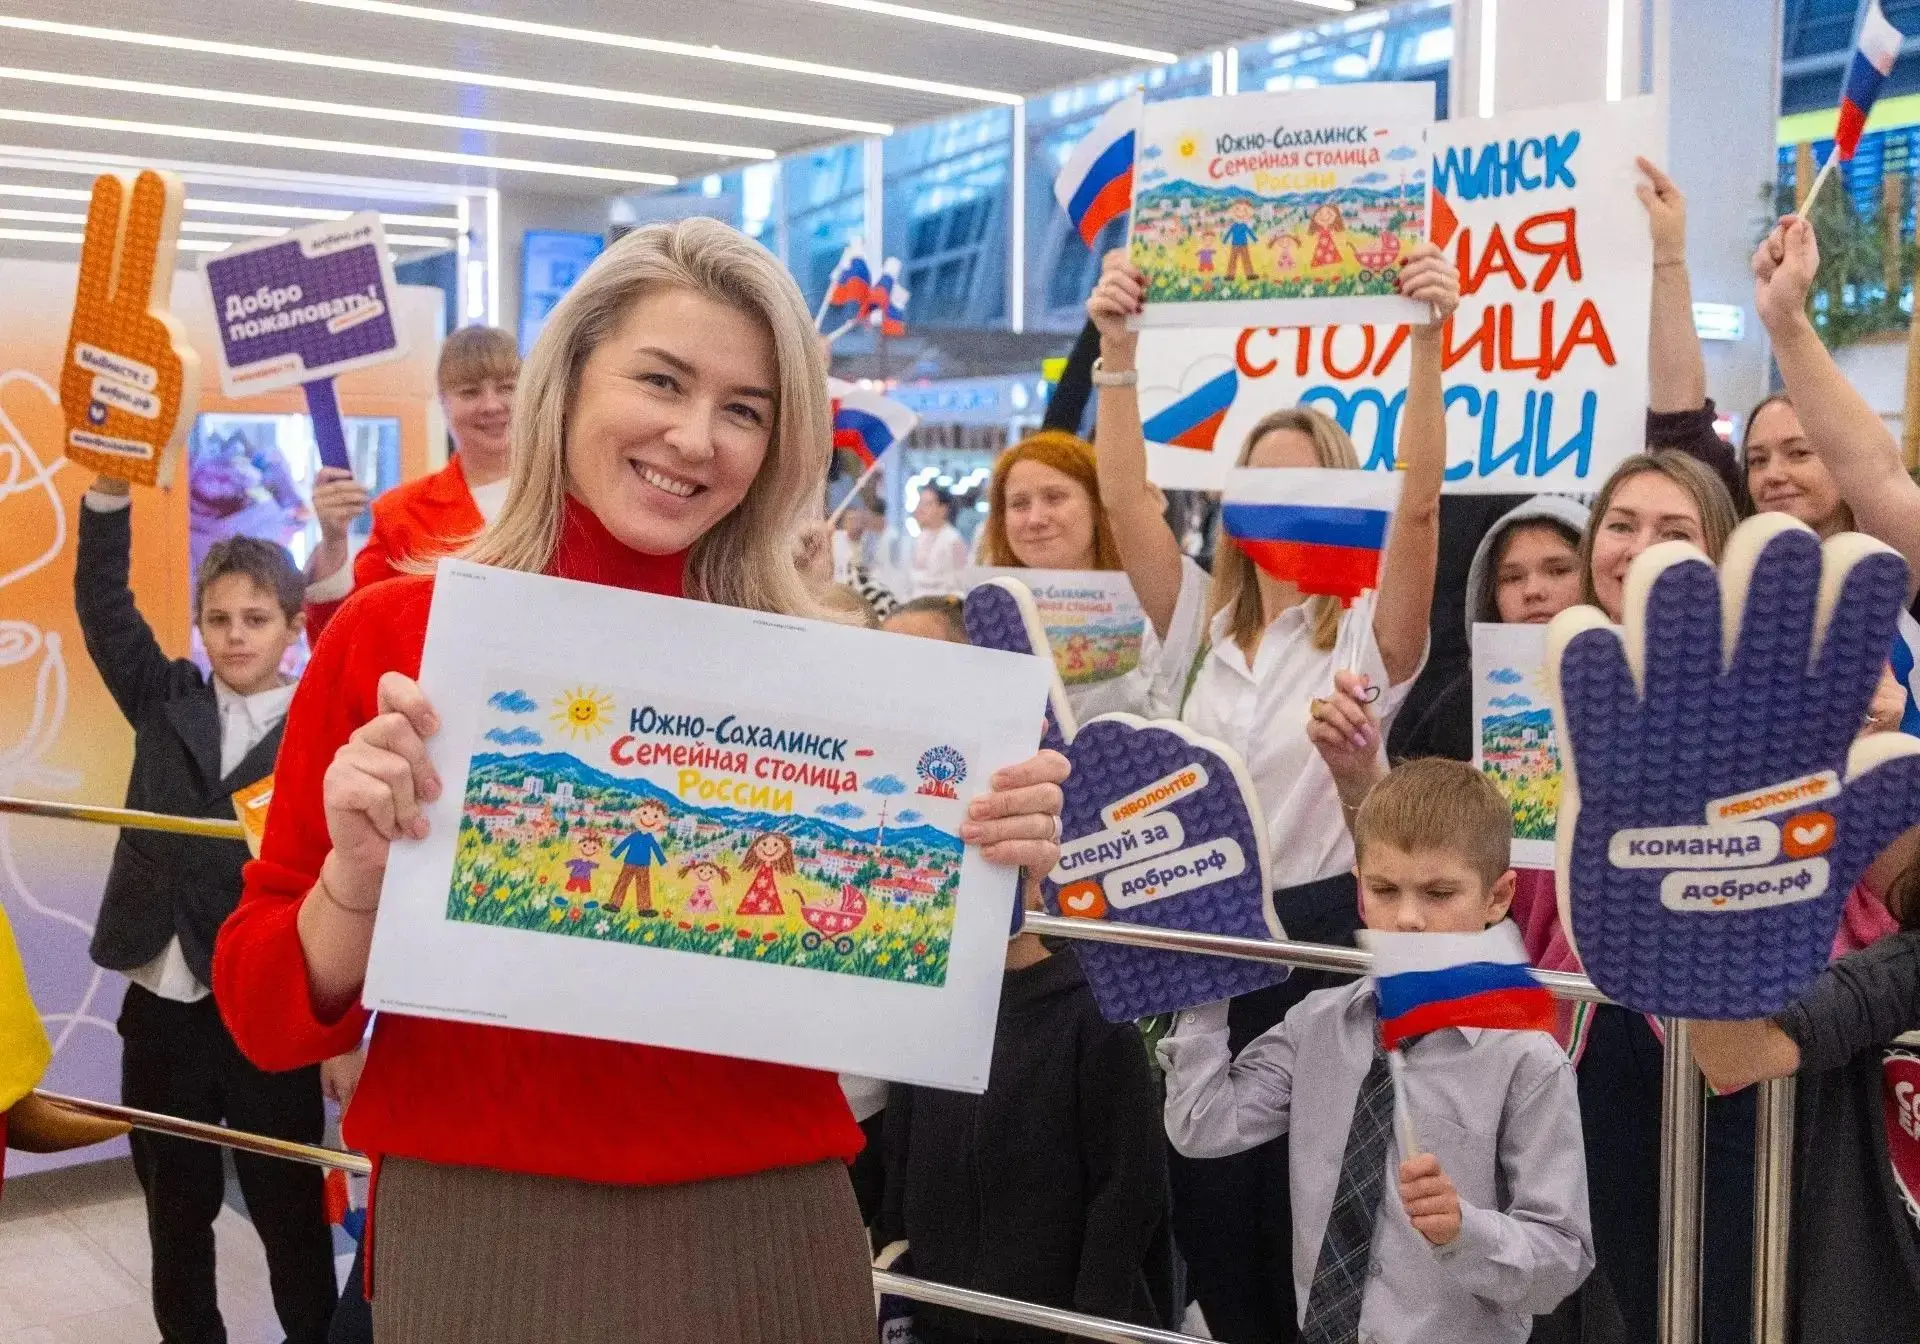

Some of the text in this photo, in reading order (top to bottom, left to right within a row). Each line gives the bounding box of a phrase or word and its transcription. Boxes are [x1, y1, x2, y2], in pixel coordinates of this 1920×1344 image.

[1216, 125, 1368, 154] Южно-Сахалинск
[1208, 146, 1381, 179] Семейная столица
[226, 283, 303, 322] Добро
[630, 705, 848, 762] Южно-Сахалинск
[610, 735, 858, 796] Семейная столица
[677, 768, 794, 813] России
[1112, 771, 1197, 823] #ЯВОЛОНТЁР
[1058, 825, 1169, 871] следуй за
[1630, 835, 1761, 858] команда
[1121, 849, 1228, 897] добро.рф
[1682, 868, 1812, 901] добро.рф
